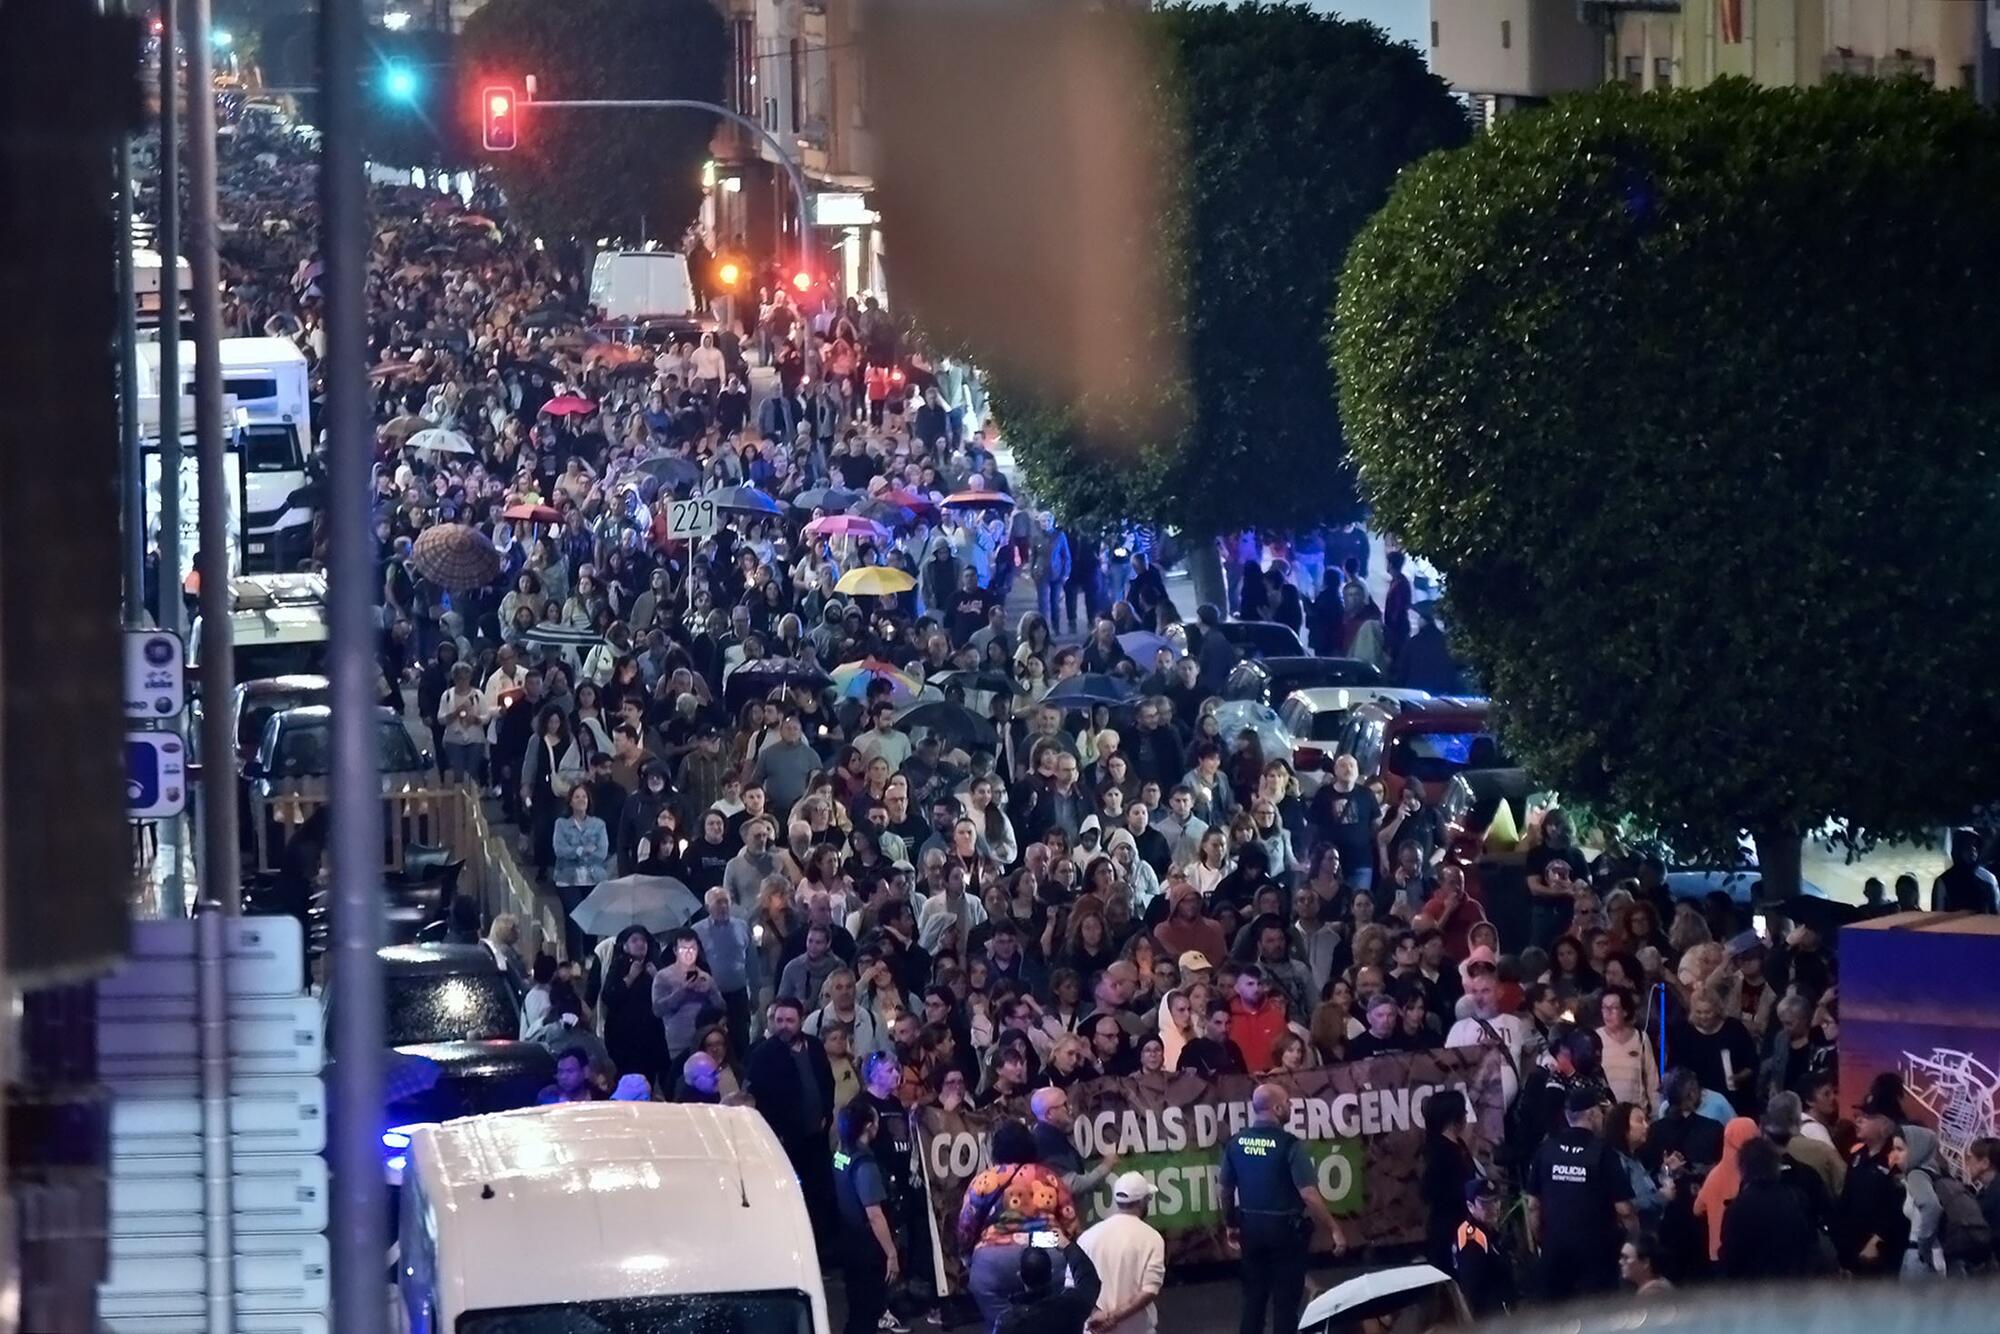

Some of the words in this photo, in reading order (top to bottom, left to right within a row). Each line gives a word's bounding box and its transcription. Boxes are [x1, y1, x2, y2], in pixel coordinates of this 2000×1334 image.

[673, 500, 713, 532] 229
[1238, 1137, 1276, 1149] GUARDIA
[1243, 1146, 1267, 1156] CIVIL
[1552, 1164, 1587, 1176] POLICIA
